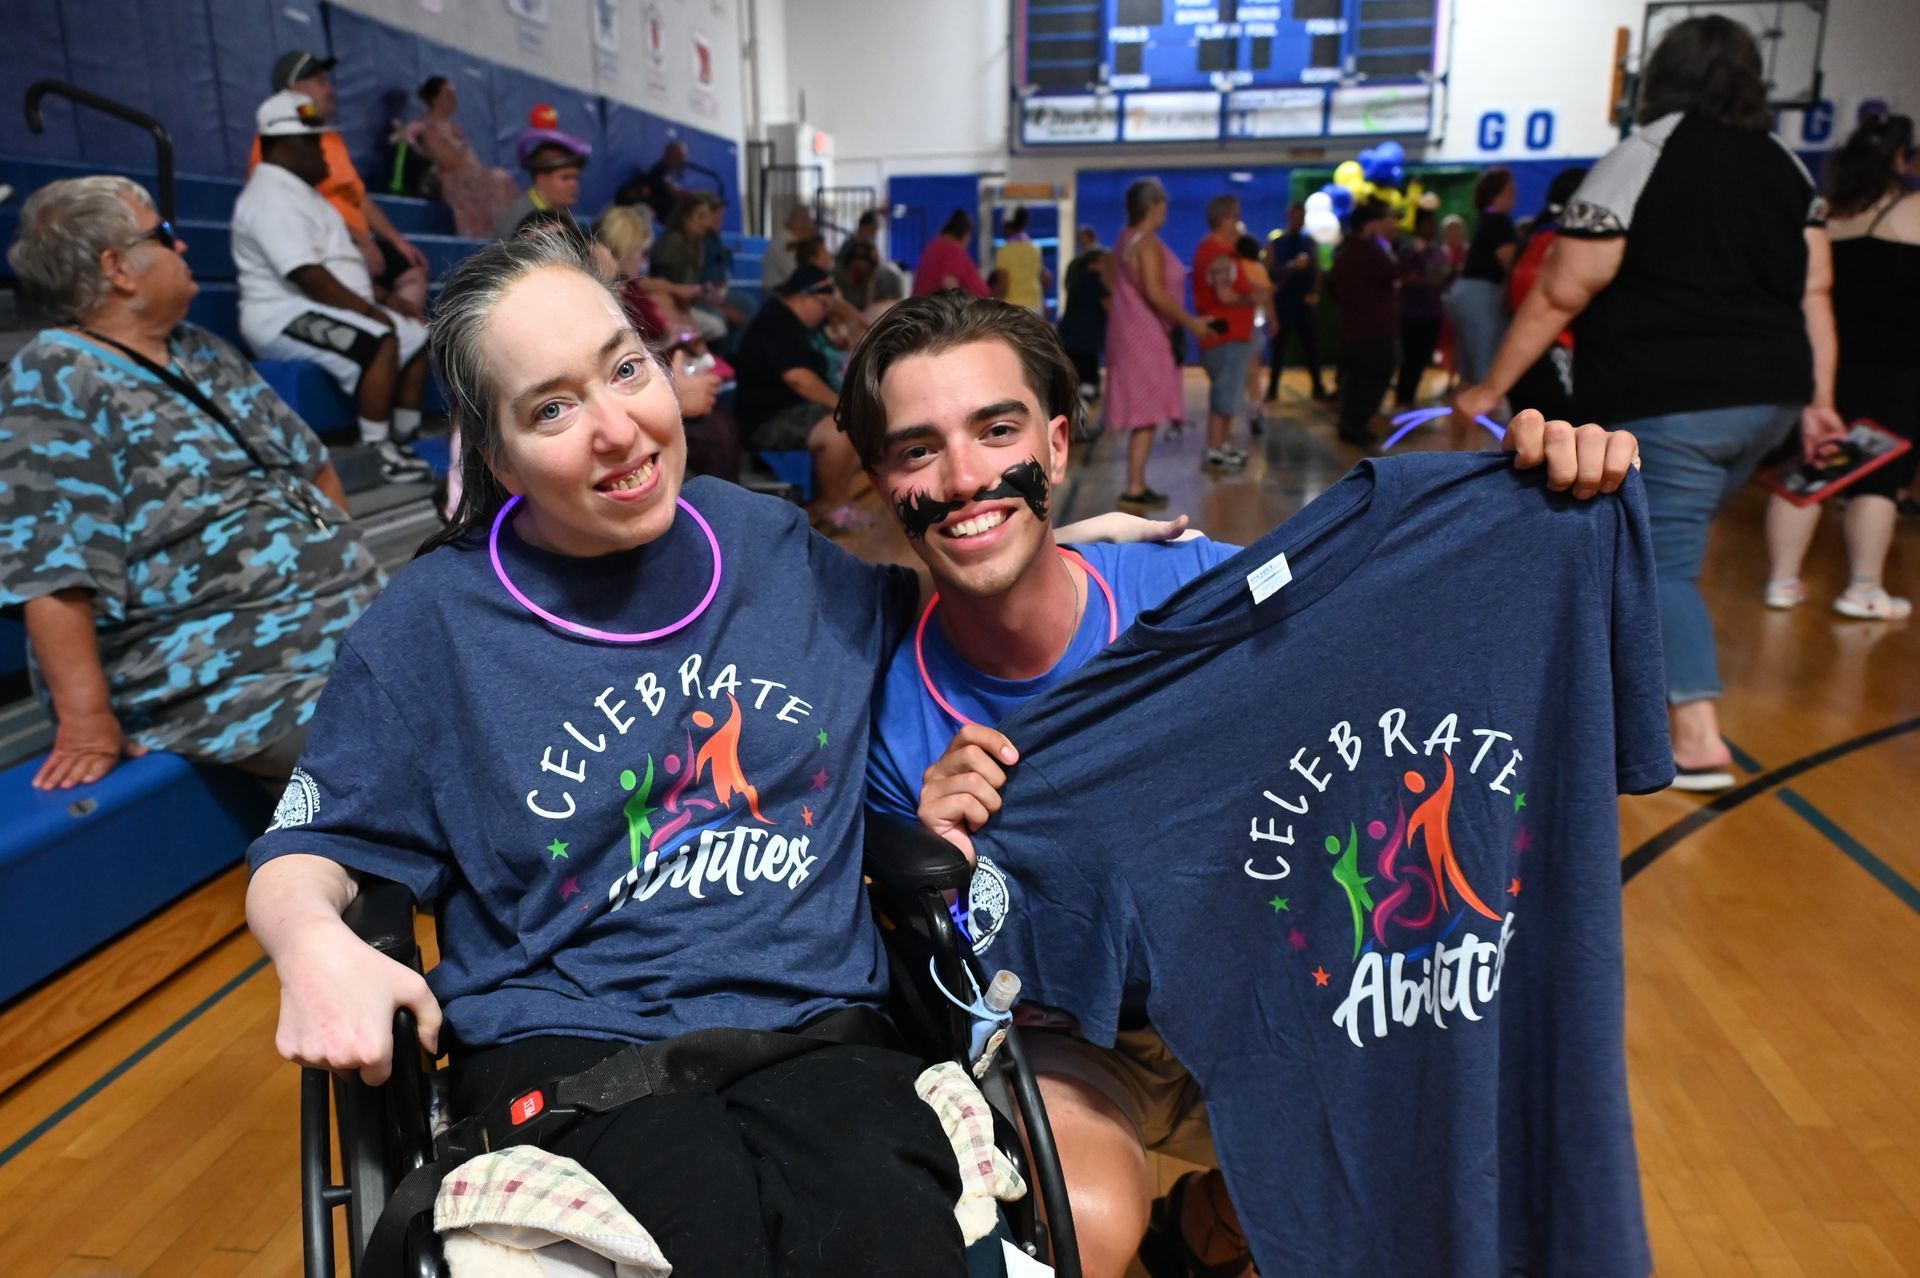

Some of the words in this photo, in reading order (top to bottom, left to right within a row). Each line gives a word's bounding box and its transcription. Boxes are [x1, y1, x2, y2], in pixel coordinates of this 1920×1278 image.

[1477, 111, 1555, 151] GO
[526, 652, 814, 820] CELEBRATE
[1243, 707, 1524, 881] CELEBRATE
[1331, 911, 1517, 1048] Abiliti
